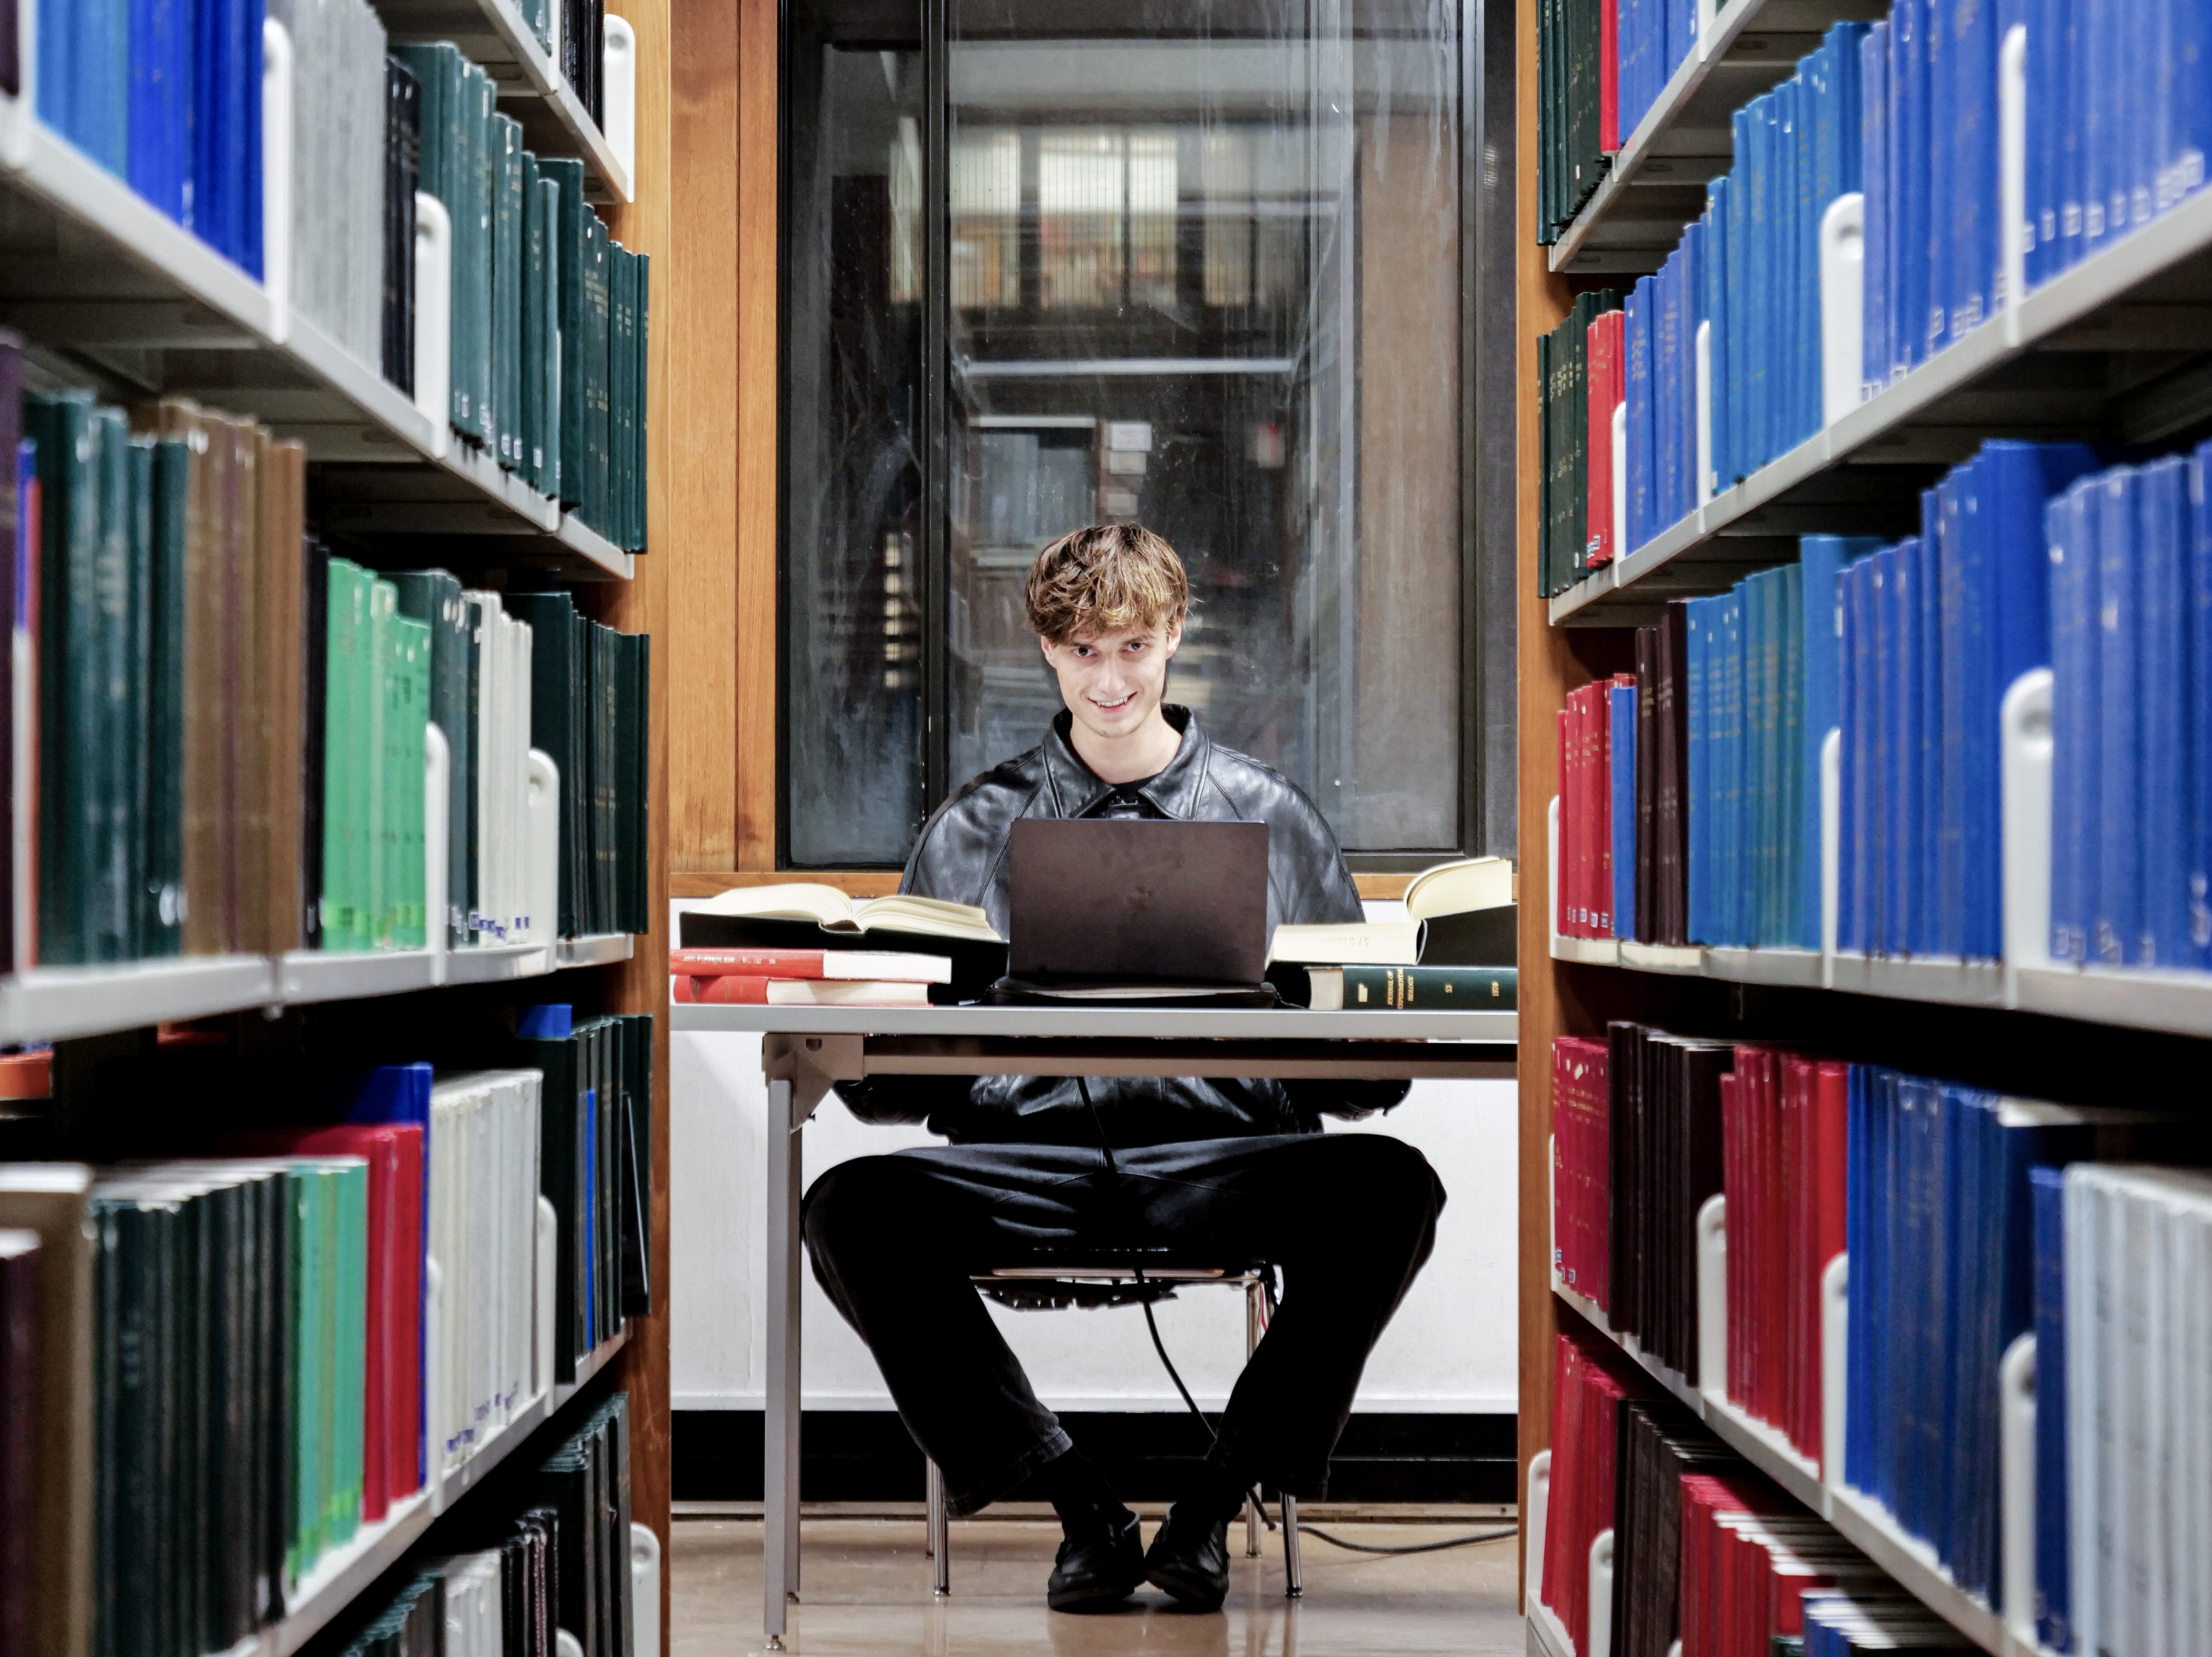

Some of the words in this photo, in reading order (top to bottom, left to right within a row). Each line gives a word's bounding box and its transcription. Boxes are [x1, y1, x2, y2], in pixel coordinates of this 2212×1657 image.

[1387, 970, 1393, 979] OF
[1444, 983, 1453, 993] 53
[1491, 980, 1499, 997] 1970
